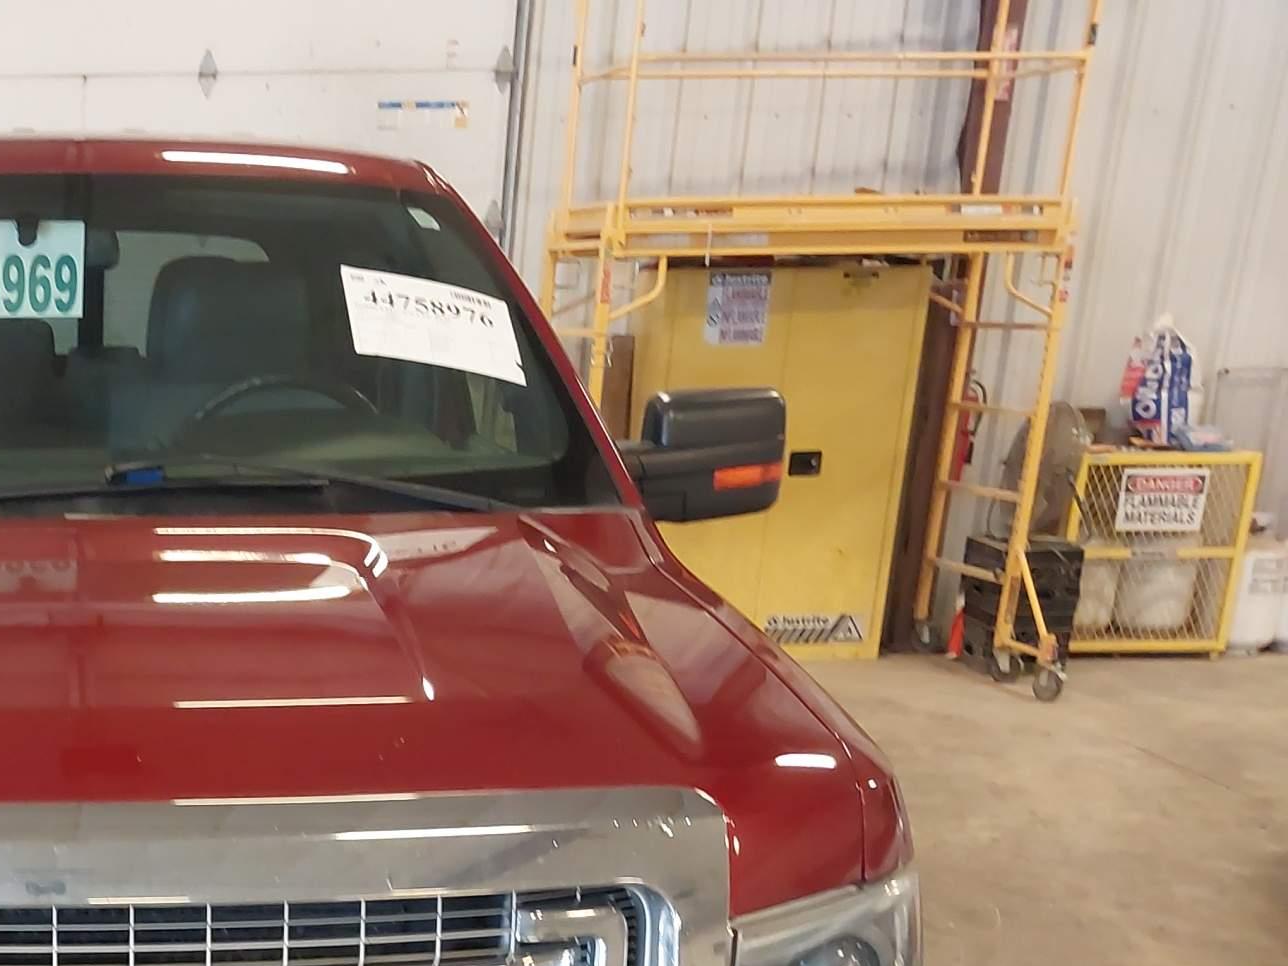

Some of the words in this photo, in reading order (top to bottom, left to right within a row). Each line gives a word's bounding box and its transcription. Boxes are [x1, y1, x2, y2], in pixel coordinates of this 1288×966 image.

[364, 289, 494, 329] 44758976
[1135, 477, 1195, 491] DANGER
[1124, 493, 1200, 509] FLAMMABLE
[1123, 510, 1197, 524] MATERIALS
